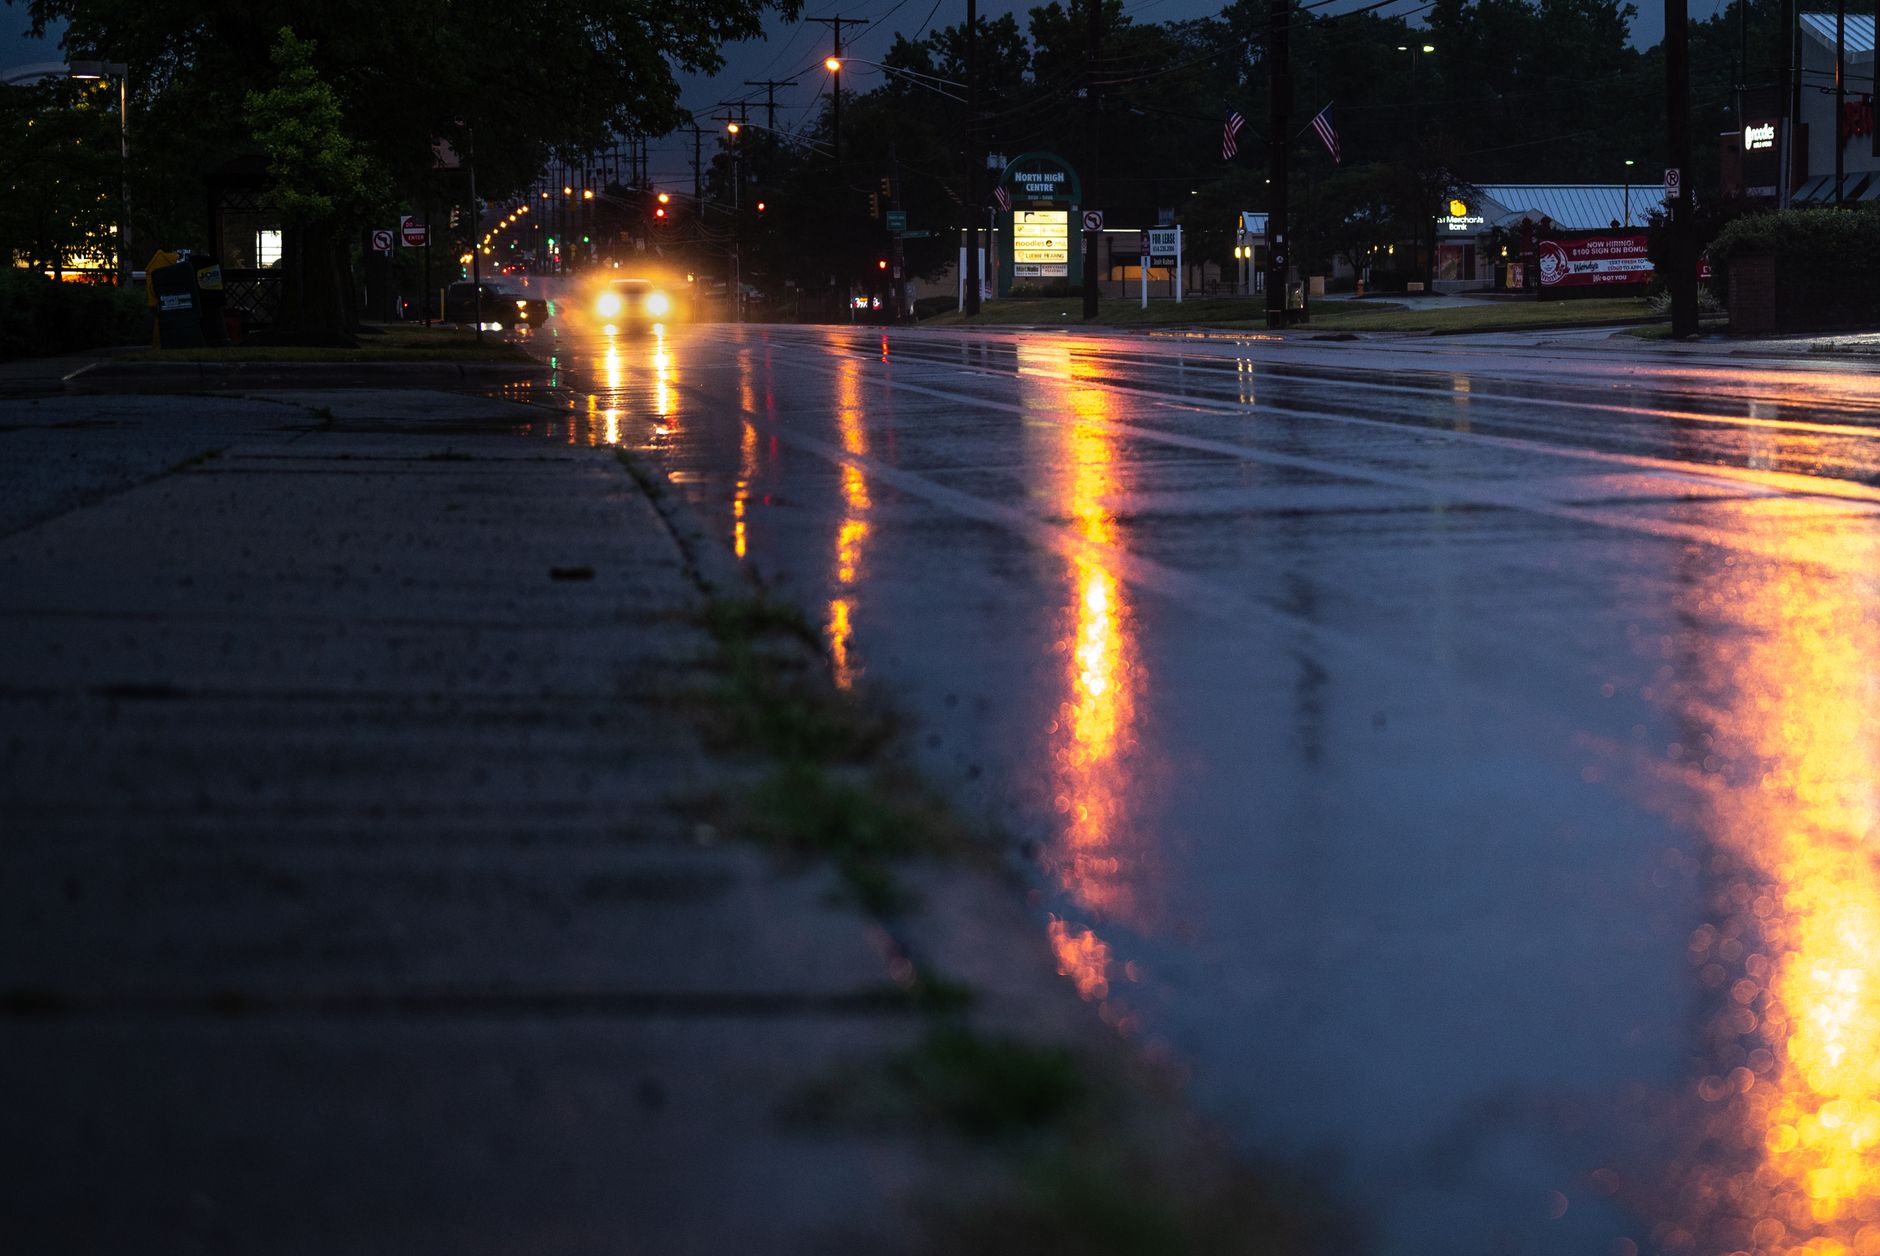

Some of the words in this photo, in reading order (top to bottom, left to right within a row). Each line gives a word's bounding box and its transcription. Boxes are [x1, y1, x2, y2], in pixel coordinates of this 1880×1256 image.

[1015, 172, 1041, 182] NORTH
[1044, 172, 1064, 182] HIGH
[1026, 183, 1054, 192] CENTRE
[1447, 216, 1484, 224] Merchants
[1449, 223, 1467, 231] Bank
[1152, 234, 1161, 244] FOR
[1162, 233, 1175, 244] LEASE
